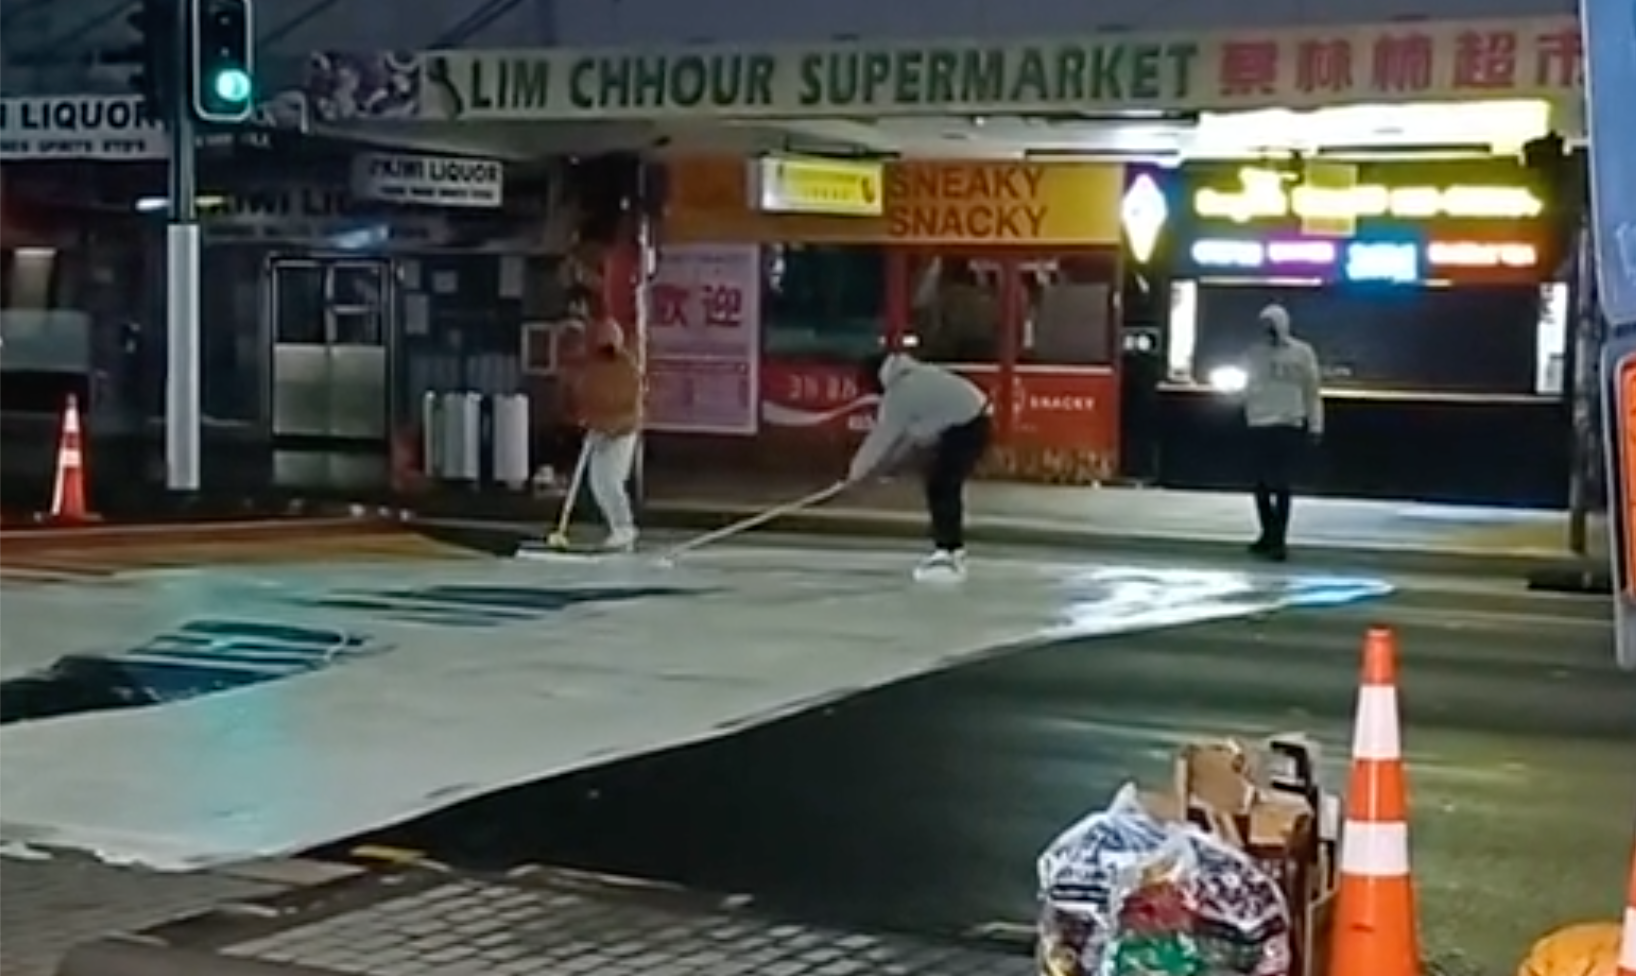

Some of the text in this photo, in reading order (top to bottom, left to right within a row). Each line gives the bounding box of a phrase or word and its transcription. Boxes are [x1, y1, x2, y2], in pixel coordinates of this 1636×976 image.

[470, 42, 1198, 110] LIM CHHOUR SUPERMARKET
[428, 161, 498, 184] LIQUOR
[890, 166, 1046, 199] SNEAKY
[889, 204, 1048, 239] SNACKY
